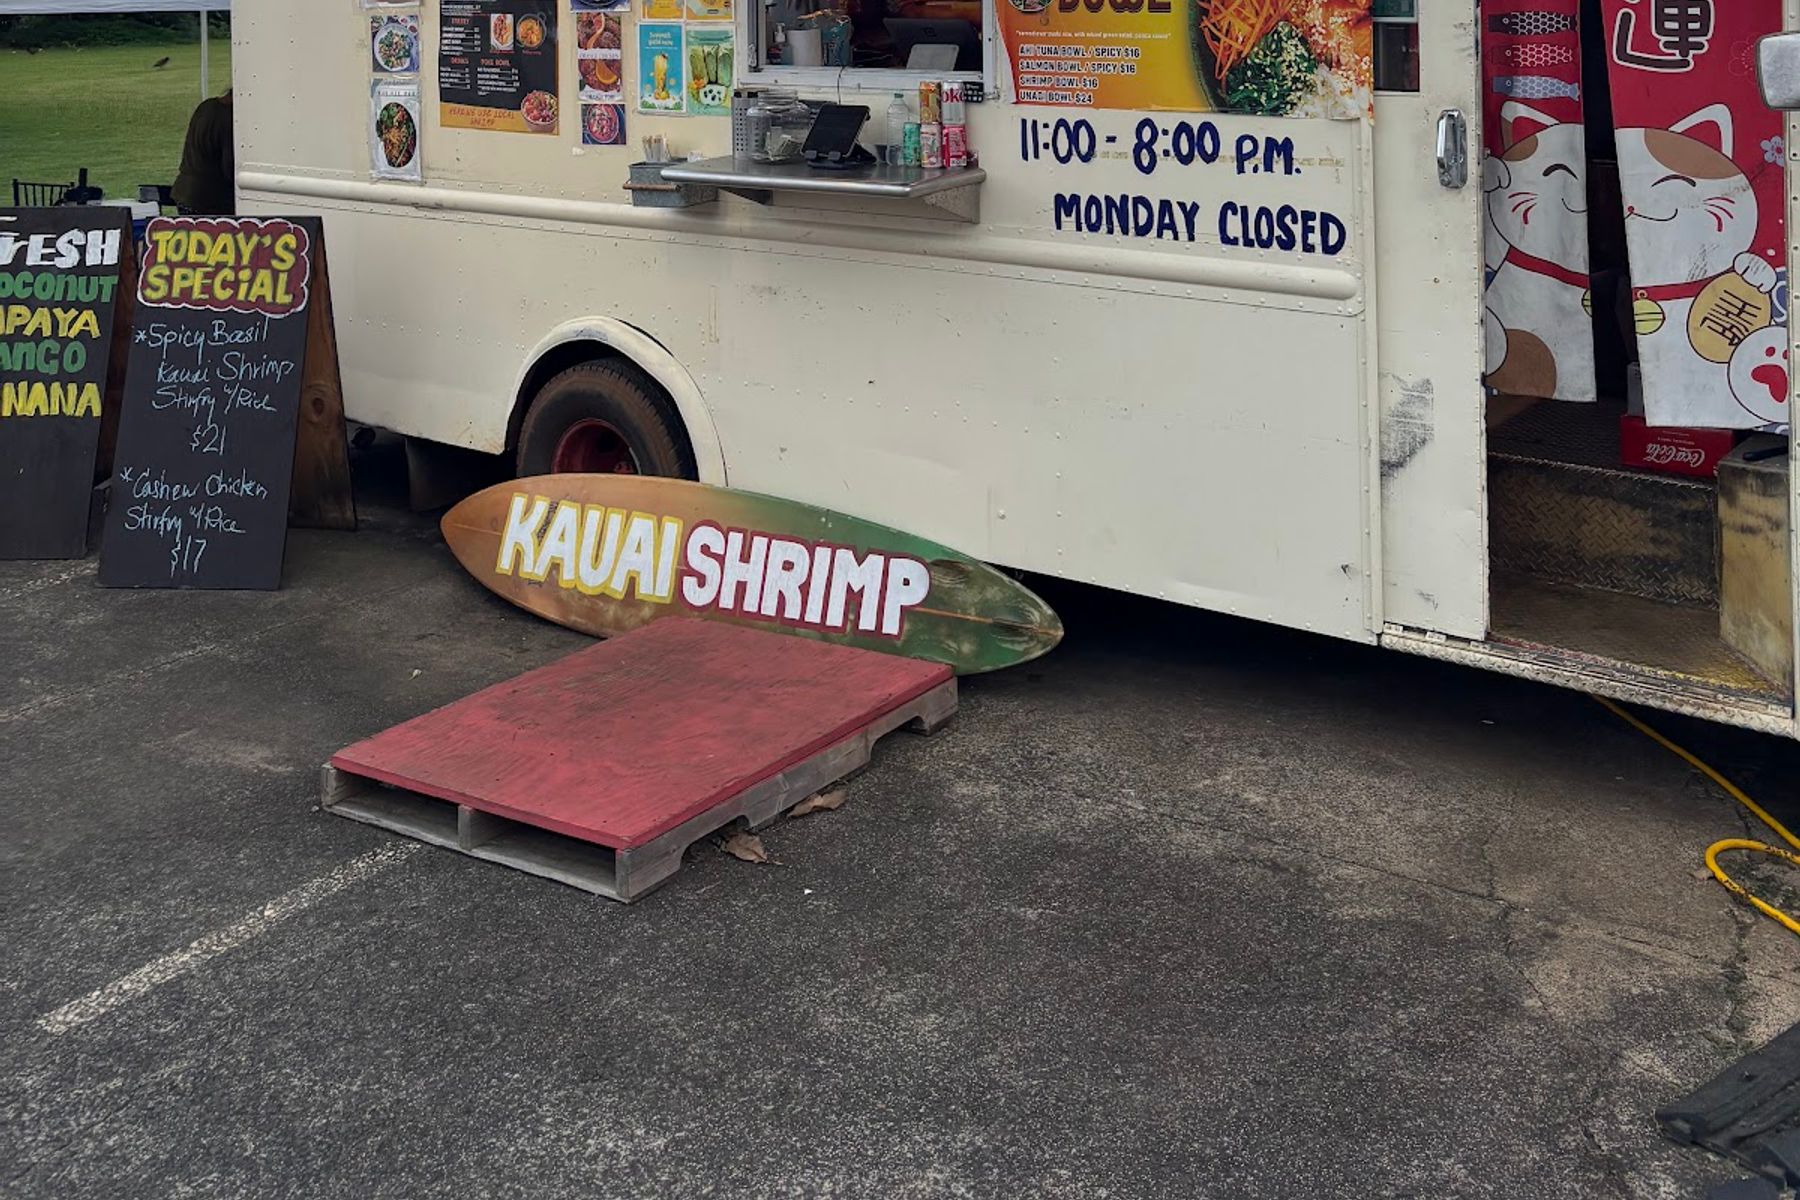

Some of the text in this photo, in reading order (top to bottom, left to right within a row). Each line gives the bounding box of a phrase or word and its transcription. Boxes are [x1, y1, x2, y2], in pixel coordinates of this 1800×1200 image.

[1019, 60, 1055, 72] SALMON
[1057, 62, 1082, 72] BOWL
[1090, 63, 1118, 73] SPICY
[1120, 64, 1136, 74] $16
[1036, 46, 1059, 57] TUNA
[1060, 47, 1086, 58] BOWL
[1094, 48, 1122, 58] SPICY
[1124, 48, 1140, 59] $16
[1019, 76, 1098, 88] SHRIMP BOWL $16
[1048, 92, 1072, 102] BOWL
[1075, 93, 1093, 104] $24
[1020, 117, 1096, 165] 11:00
[1132, 117, 1221, 175] 8:00
[1234, 134, 1302, 175] P.M.
[1053, 192, 1347, 256] MONDAY CLOSED
[150, 229, 298, 271] TODAY'S
[0, 304, 101, 339] PAYA
[208, 316, 269, 346] Basil
[216, 351, 295, 384] Shrimp
[190, 424, 226, 456] $21
[205, 469, 269, 500] Chicken
[170, 539, 208, 578] $17
[496, 492, 931, 638] KAUAI SHRIMP
